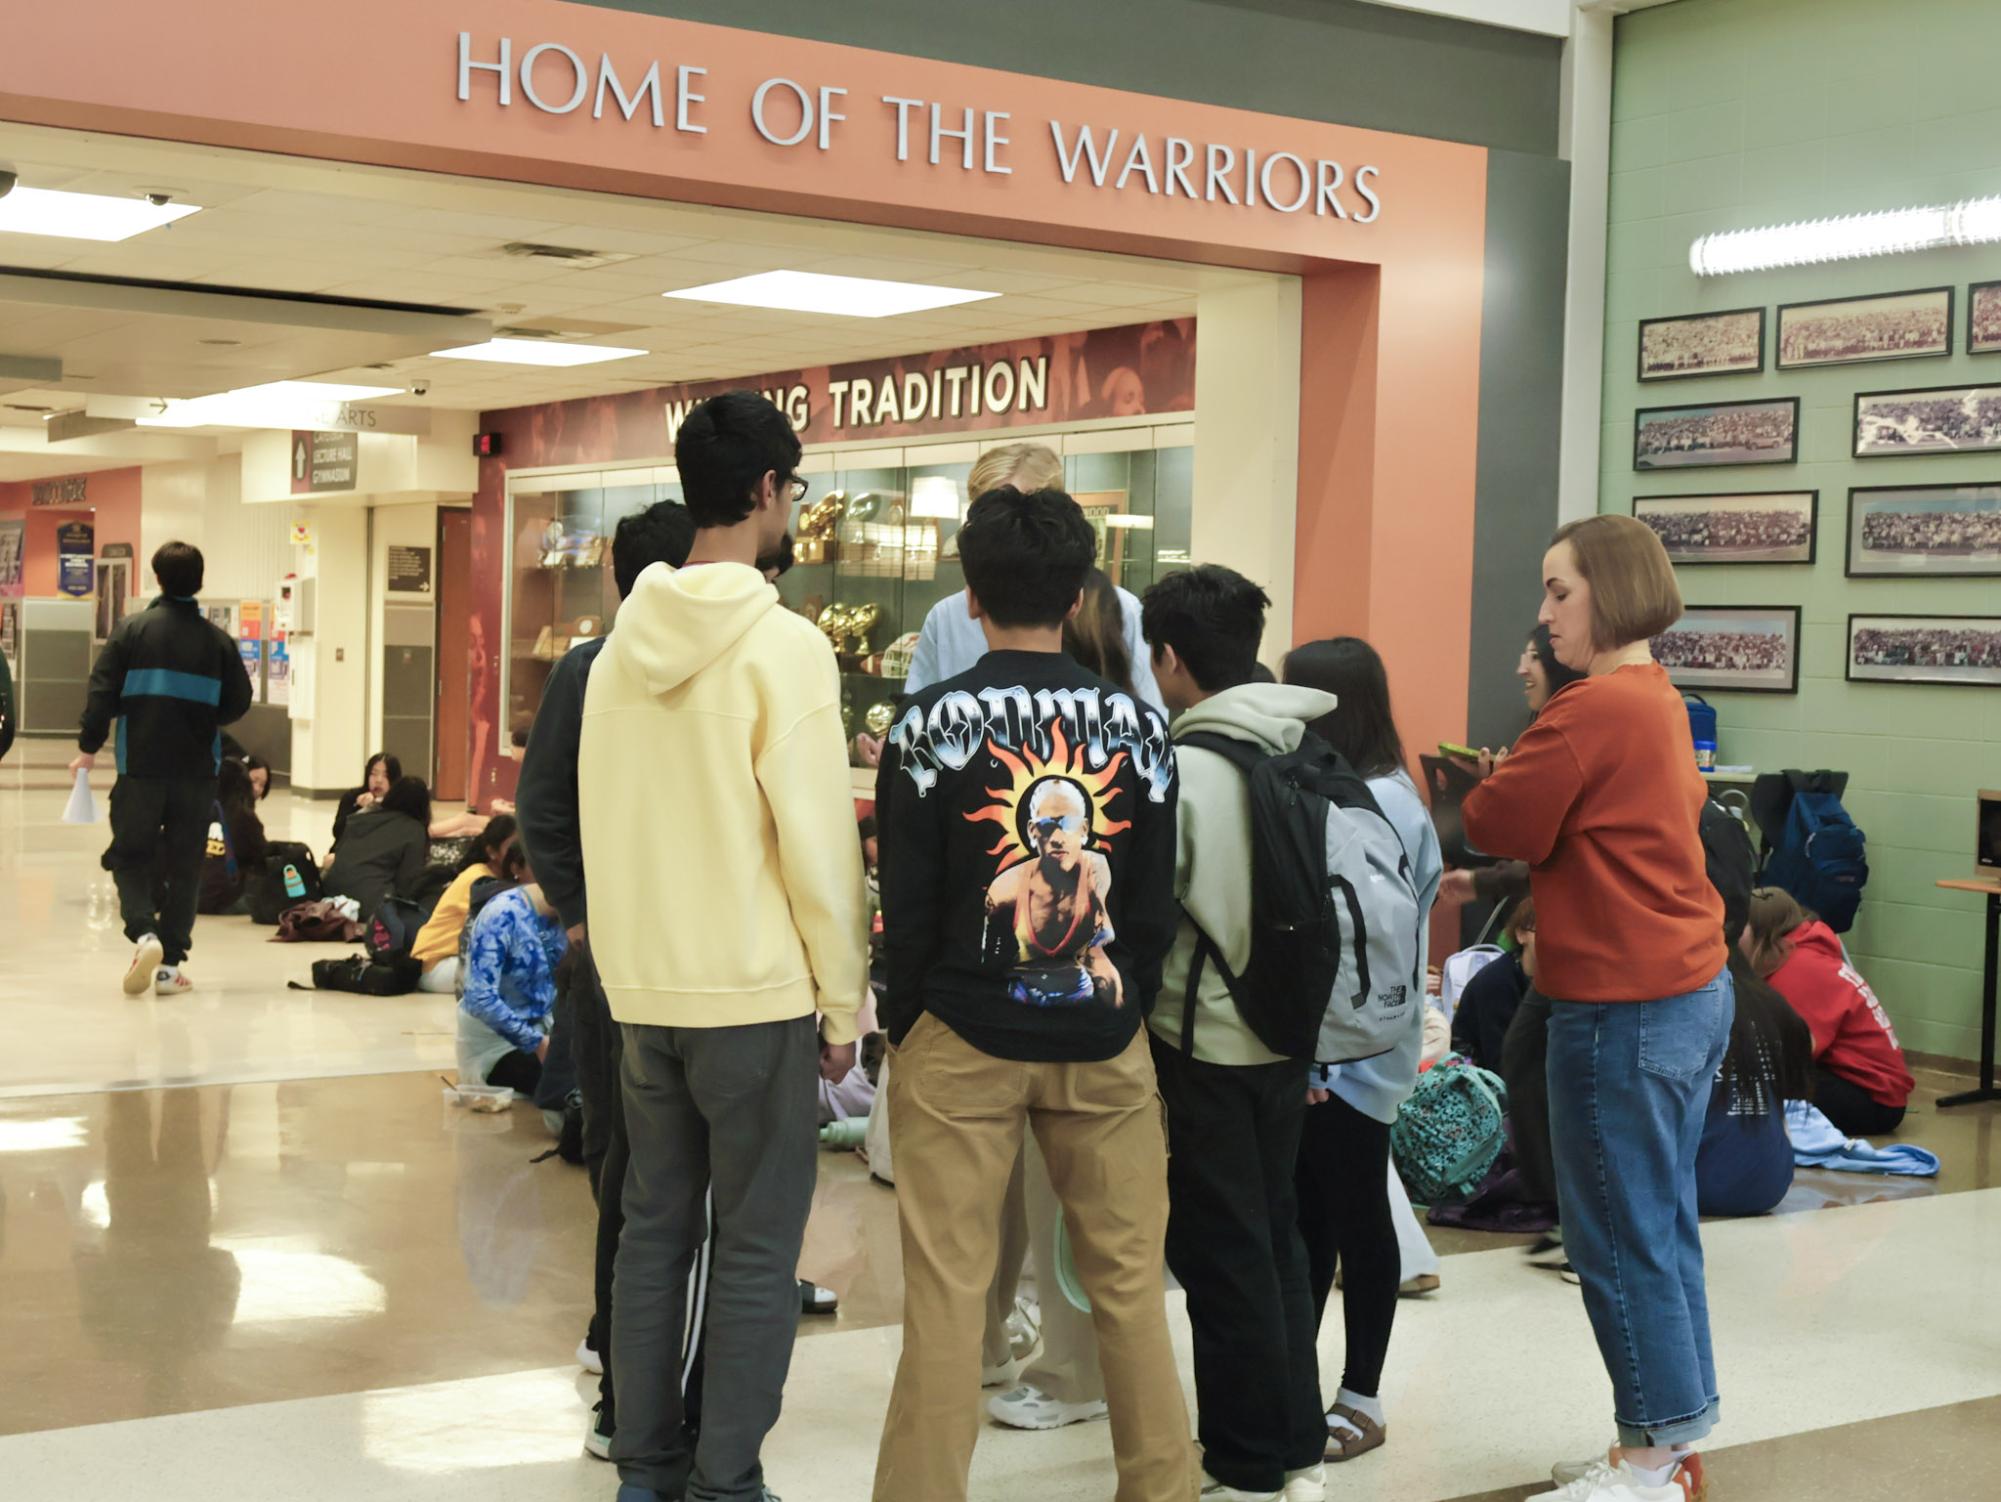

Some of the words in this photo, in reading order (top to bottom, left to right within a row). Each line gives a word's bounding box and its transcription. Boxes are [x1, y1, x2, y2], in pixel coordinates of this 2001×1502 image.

[458, 32, 708, 134] HOME
[751, 77, 849, 150] OF
[881, 95, 1013, 174] THE
[1049, 119, 1381, 224] WARRIORS
[336, 409, 377, 428] ARTS
[828, 356, 1049, 429] TRADITION
